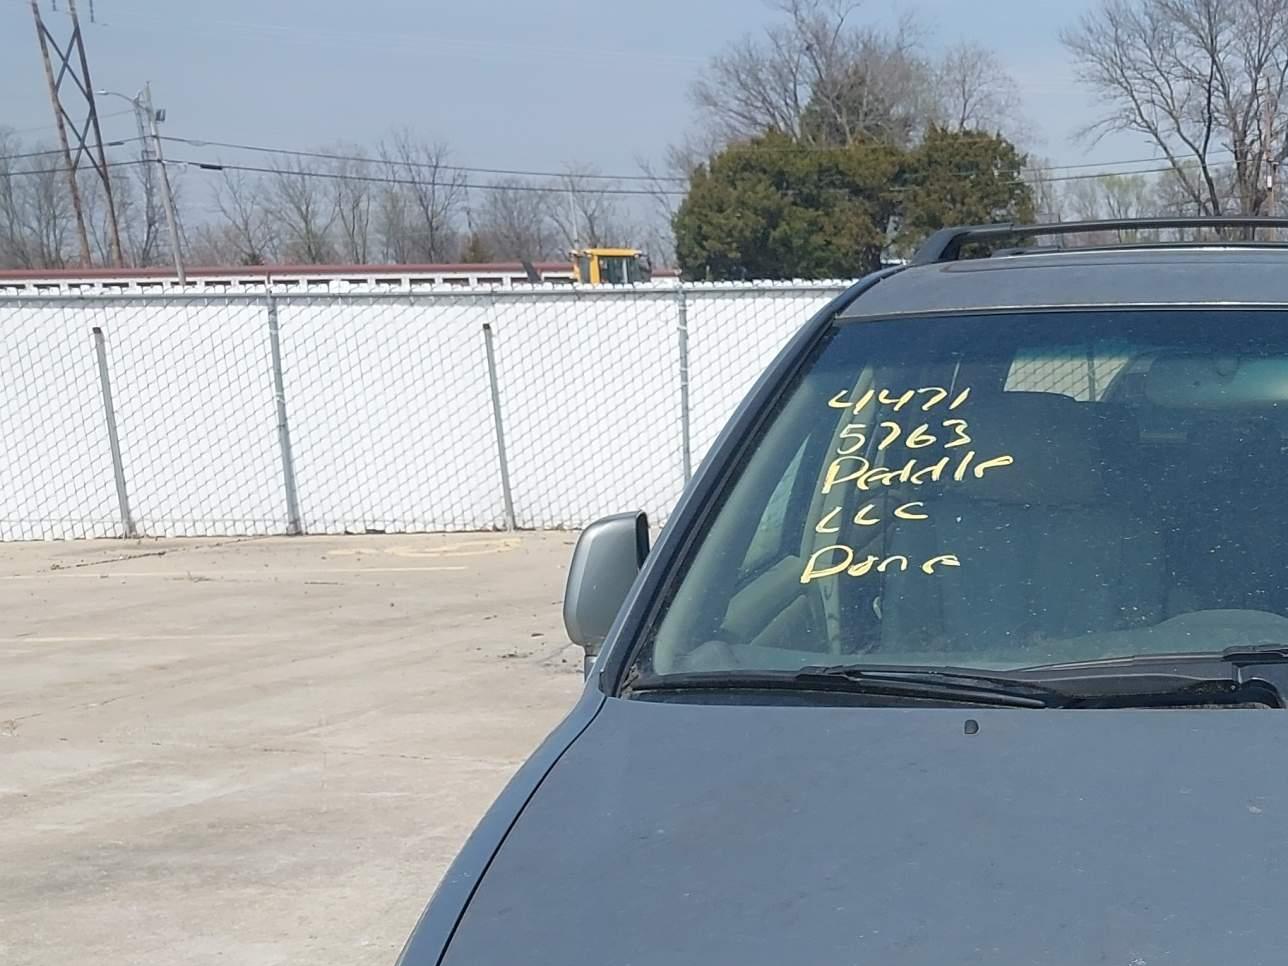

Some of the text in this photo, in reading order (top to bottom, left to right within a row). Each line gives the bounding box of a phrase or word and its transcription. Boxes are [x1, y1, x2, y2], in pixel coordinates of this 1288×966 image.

[828, 387, 971, 415] 4471
[836, 419, 971, 455] 5763
[815, 502, 928, 533] LLC
[800, 545, 960, 584] Done
